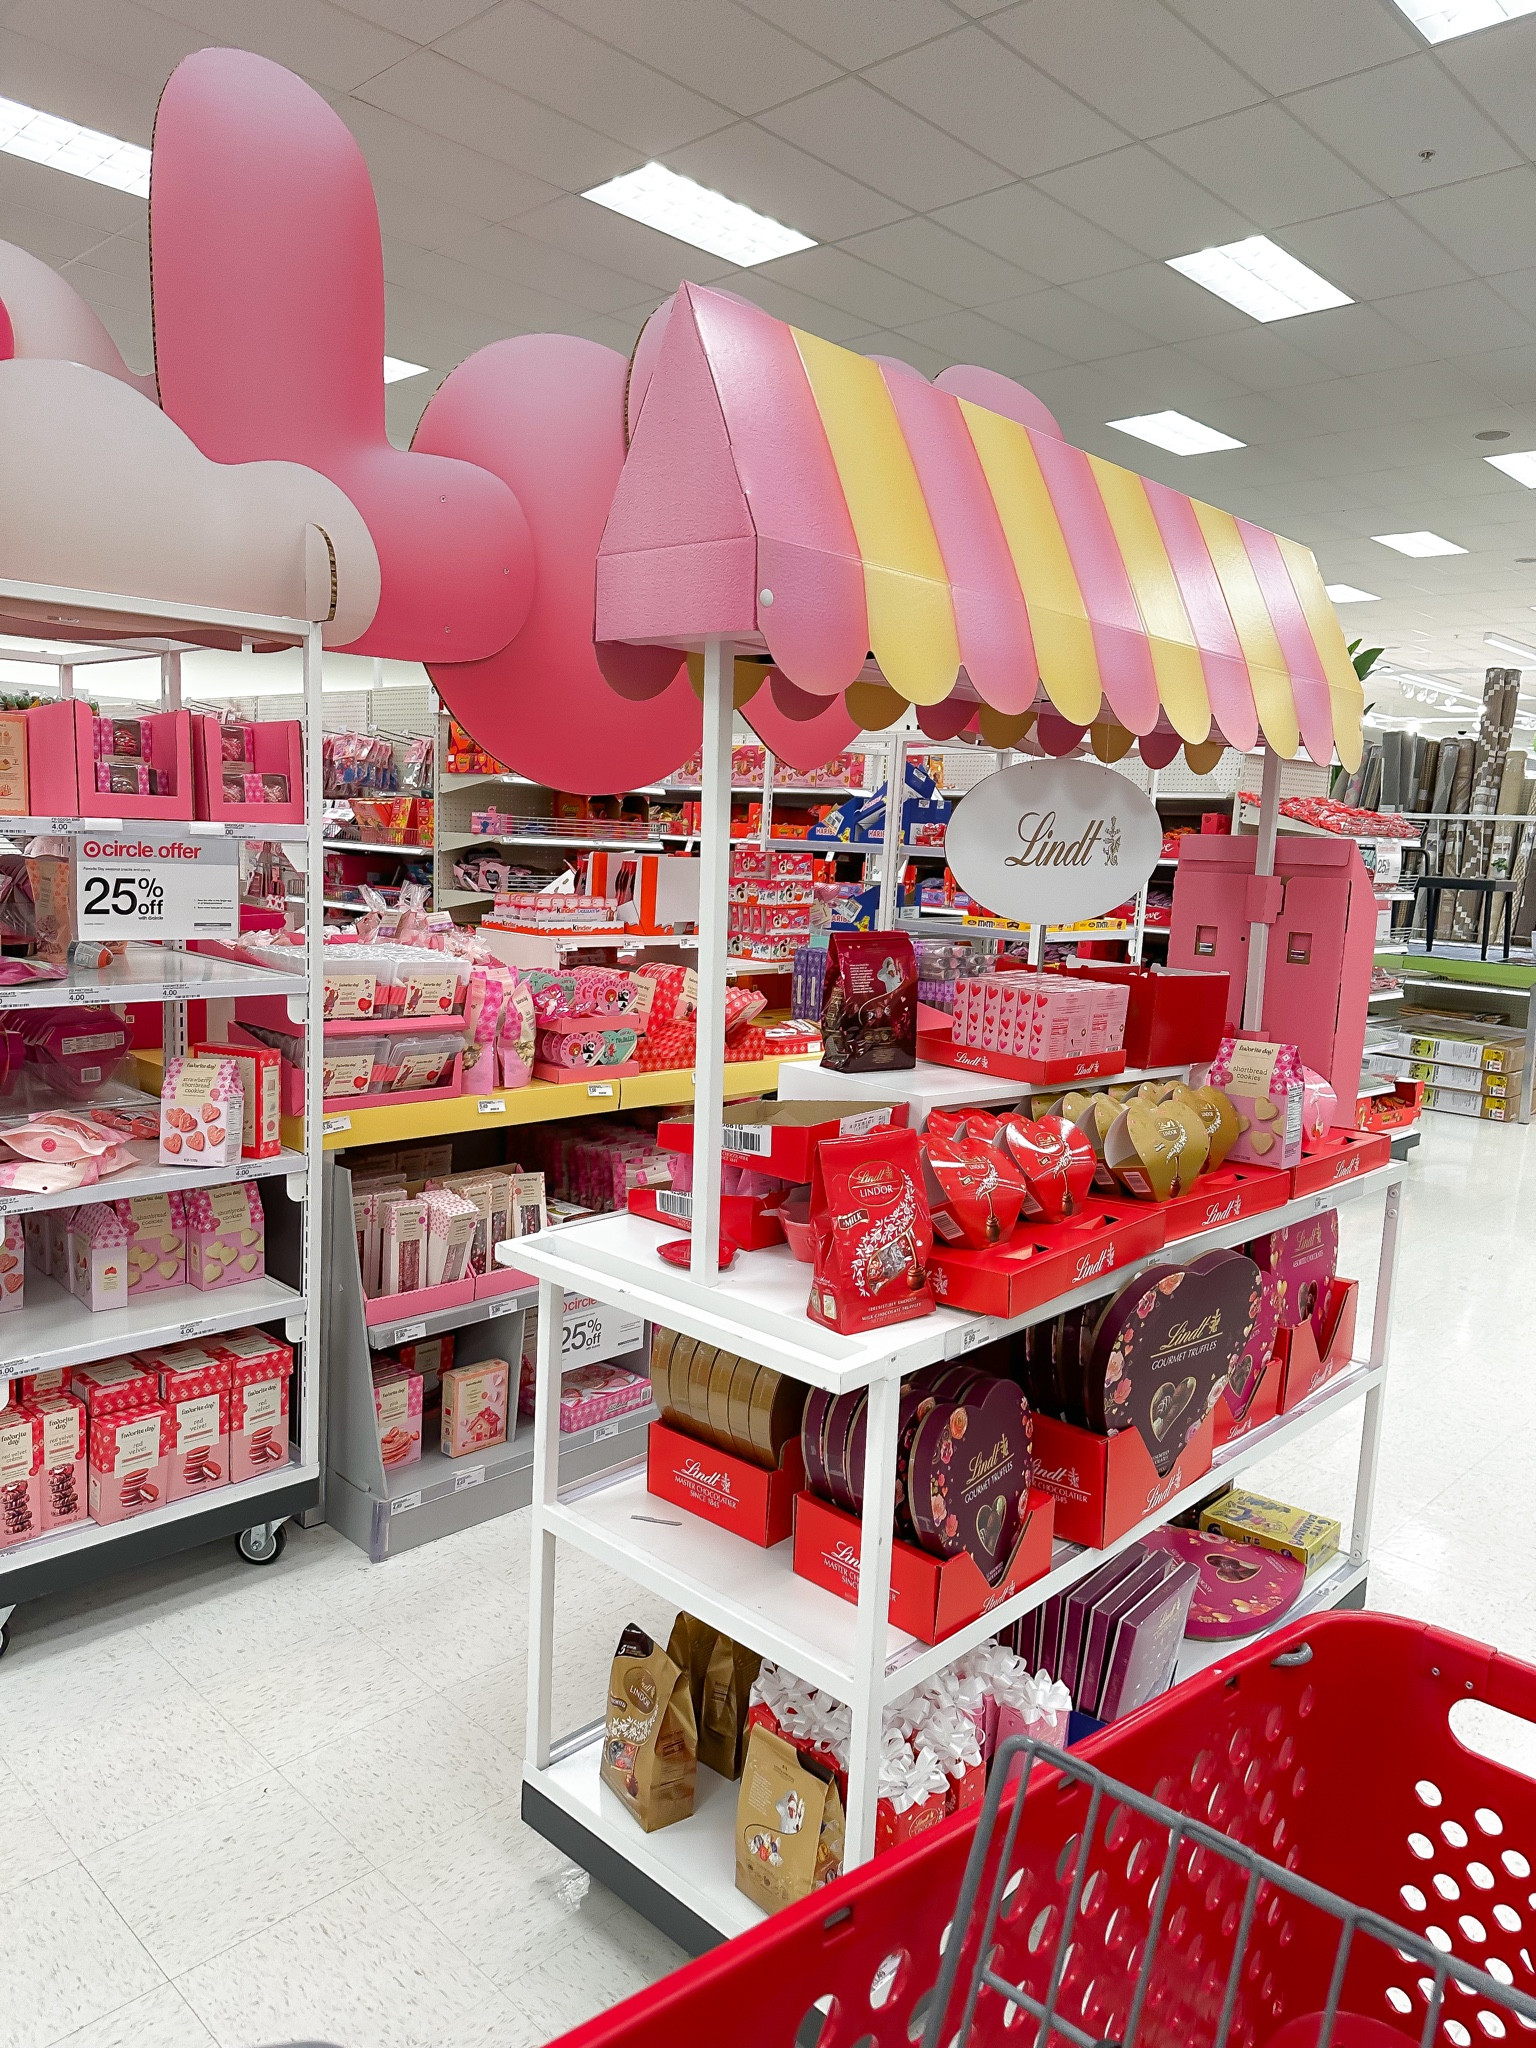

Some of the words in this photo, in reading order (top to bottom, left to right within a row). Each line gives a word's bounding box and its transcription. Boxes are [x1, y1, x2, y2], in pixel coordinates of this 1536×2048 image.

[1004, 811, 1104, 867] Lindt
[102, 840, 154, 858] circle
[158, 843, 202, 859] offer
[84, 877, 164, 915] 25%
[138, 900, 164, 915] off
[954, 1052, 983, 1066] Lindt
[1074, 1063, 1095, 1076] Lindt
[1233, 1066, 1268, 1076] shortbread
[1236, 1073, 1261, 1082] cookies
[1333, 1158, 1354, 1179] Lindt
[857, 1169, 886, 1184] Lindt
[859, 1184, 894, 1198] LINDOR
[136, 1212, 167, 1221] shortbread
[217, 1206, 246, 1216] shortbread
[222, 1213, 243, 1221] cookies
[1202, 1203, 1234, 1226] Lindt
[844, 1212, 863, 1227] MILK
[1072, 1253, 1107, 1283] Lindt
[586, 1332, 601, 1347] off
[1160, 1315, 1211, 1351] Lindt
[1151, 1351, 1186, 1371] GOURMET
[1188, 1340, 1218, 1357] TRUFFLES
[1308, 1366, 1328, 1392] Lindt
[247, 1388, 267, 1398] favorite
[267, 1384, 278, 1393] day
[181, 1405, 203, 1416] favorite
[204, 1402, 216, 1411] day
[255, 1404, 271, 1412] velvet
[258, 1399, 268, 1407] red
[49, 1416, 74, 1427] favorite
[189, 1422, 207, 1432] velvet
[193, 1417, 204, 1426] red
[1, 1431, 26, 1442] favorite
[121, 1429, 144, 1439] favorite
[145, 1424, 156, 1434] day
[1227, 1422, 1247, 1440] Lindt
[128, 1447, 147, 1455] velvet
[133, 1441, 143, 1449] red
[965, 1442, 1000, 1485] Lindt
[681, 1458, 721, 1487] Lindt
[964, 1478, 992, 1503] GOURMET
[992, 1461, 1013, 1485] TRUFFLES
[674, 1475, 696, 1491] MASTER
[696, 1485, 737, 1509] CHOCOLATIER
[1038, 1480, 1088, 1503] CHOCOLATIER
[1142, 1477, 1176, 1515] Lindt
[690, 1490, 706, 1503] SINCE
[707, 1498, 720, 1509] 1845
[831, 1541, 860, 1570] Lin
[823, 1558, 848, 1577] MASTER
[978, 1586, 1008, 1616] Lindt
[629, 1685, 651, 1709] LINDOR
